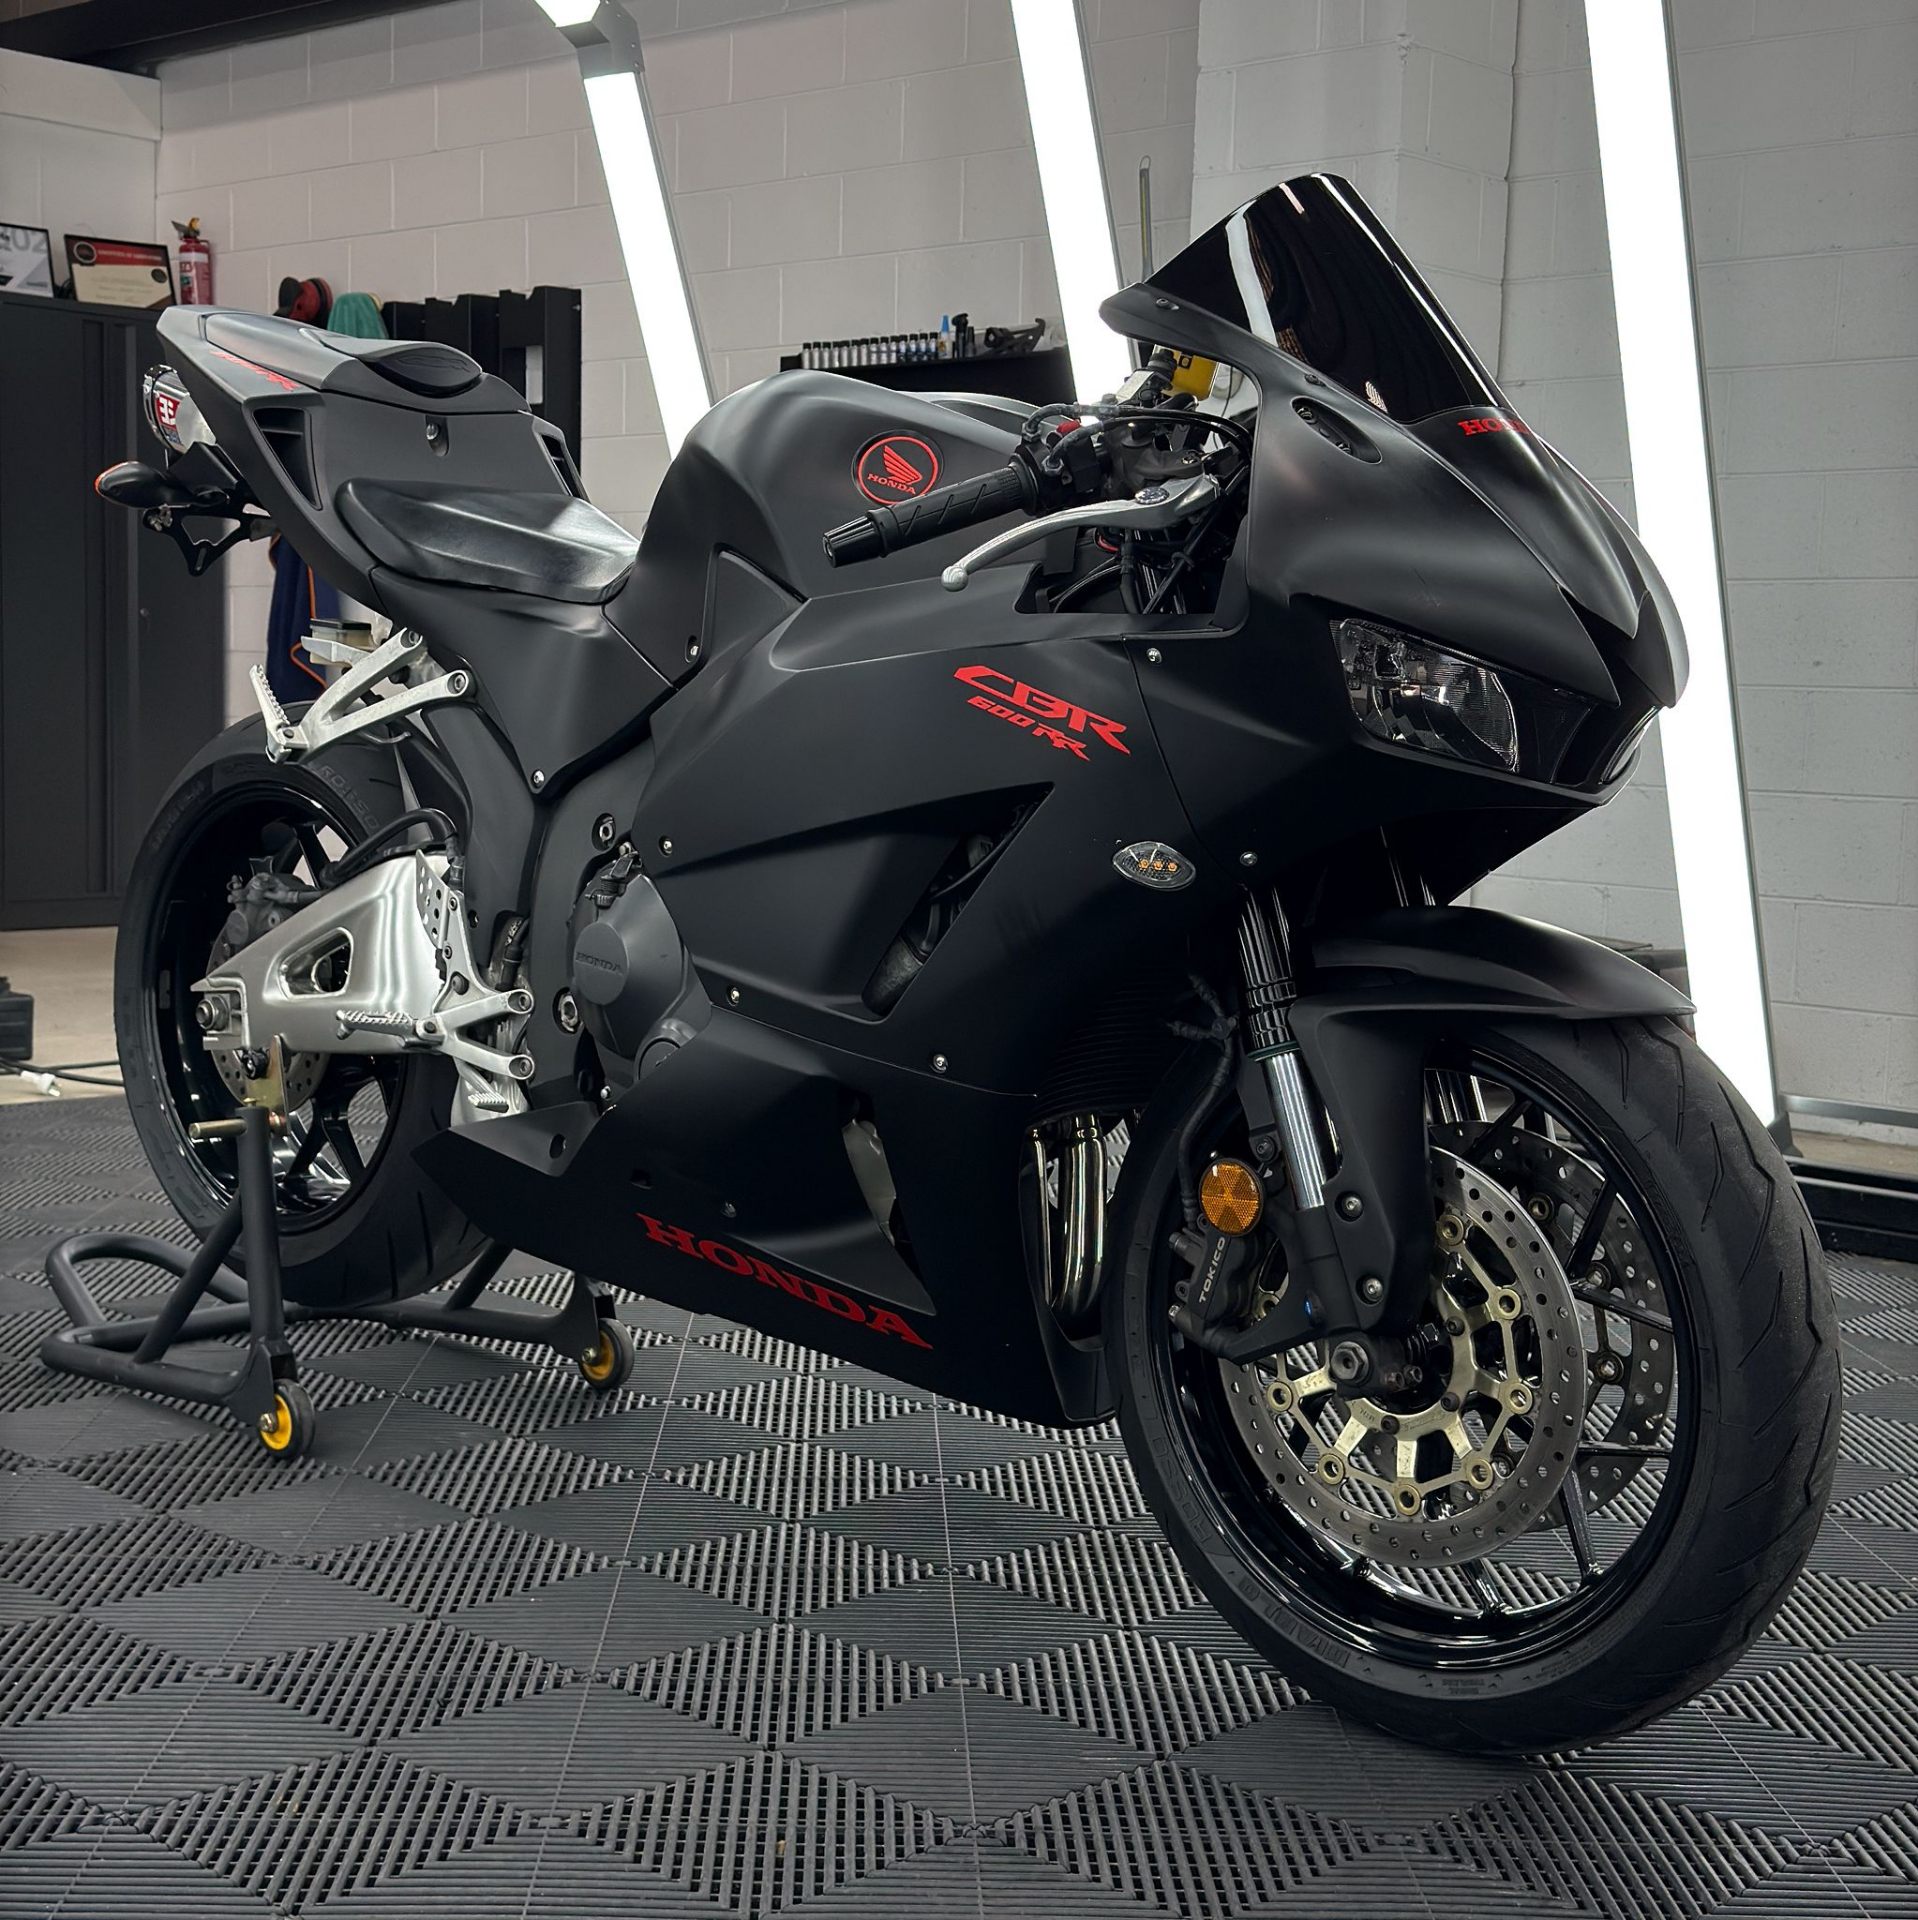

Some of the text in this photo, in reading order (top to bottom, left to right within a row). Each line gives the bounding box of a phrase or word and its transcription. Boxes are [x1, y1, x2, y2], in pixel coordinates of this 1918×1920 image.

[867, 473, 917, 495] HONDA
[953, 665, 1131, 756] CBR
[575, 951, 624, 977] HONDA
[636, 1212, 934, 1350] HONDA
[1198, 1236, 1226, 1303] TOKICO
